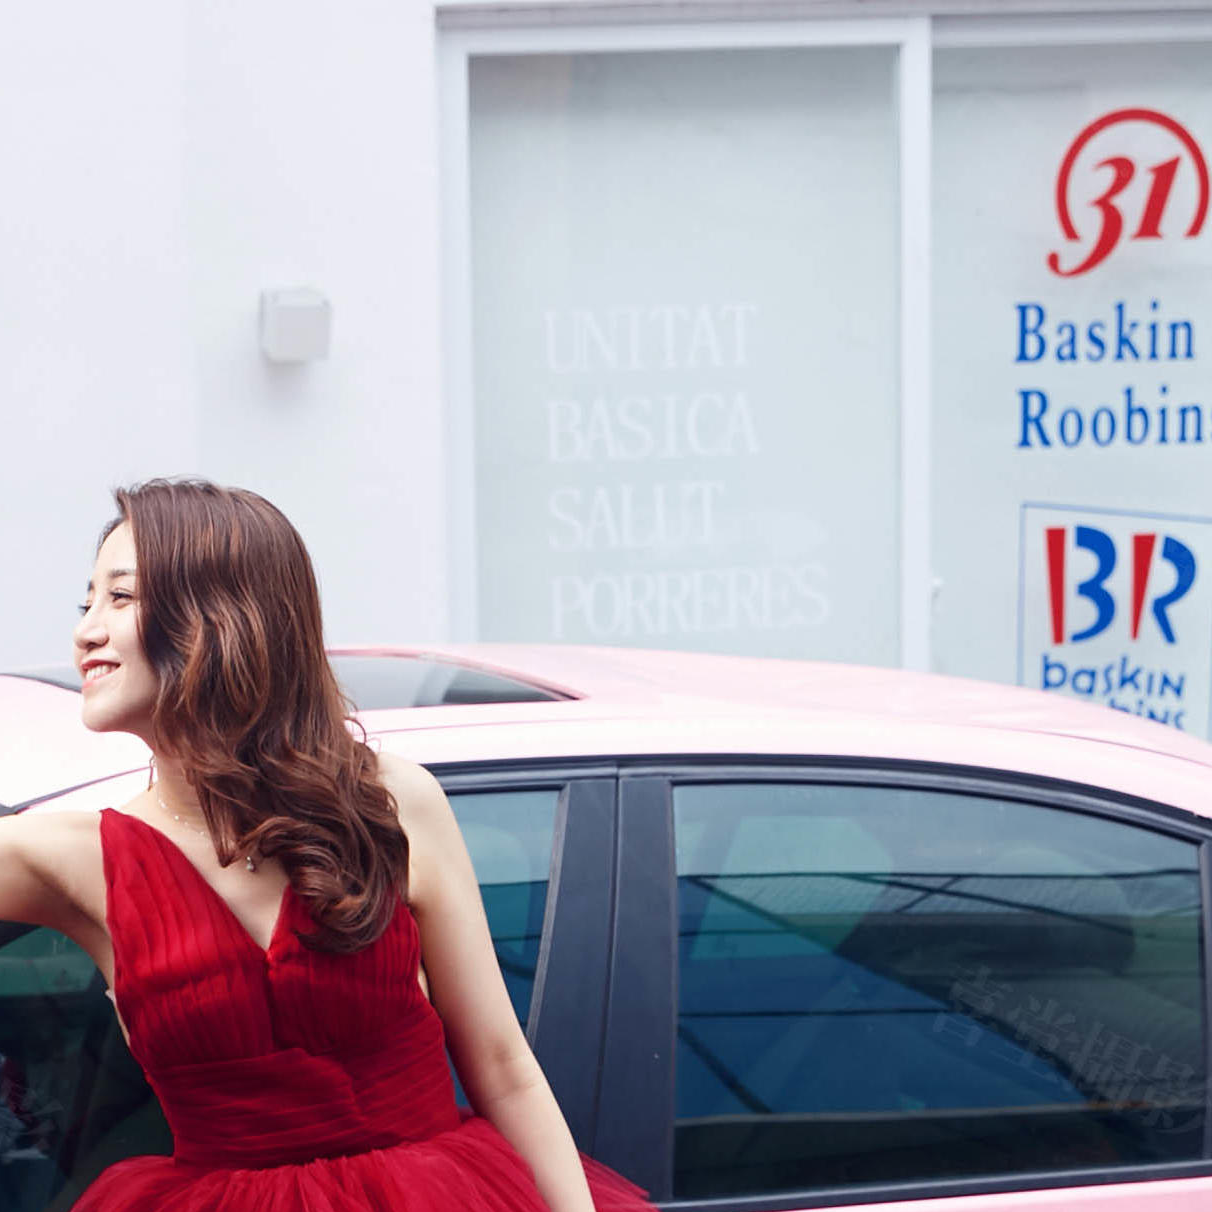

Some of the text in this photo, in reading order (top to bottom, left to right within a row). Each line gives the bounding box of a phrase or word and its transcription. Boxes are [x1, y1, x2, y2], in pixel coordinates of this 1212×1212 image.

[1047, 155, 1182, 278] 31
[542, 302, 759, 374] UNITAT
[1014, 299, 1194, 363] Baskin
[548, 391, 761, 463] BASICA
[1017, 385, 1212, 448] Roobin
[548, 481, 727, 552] SALUT
[1045, 524, 1197, 645] BR
